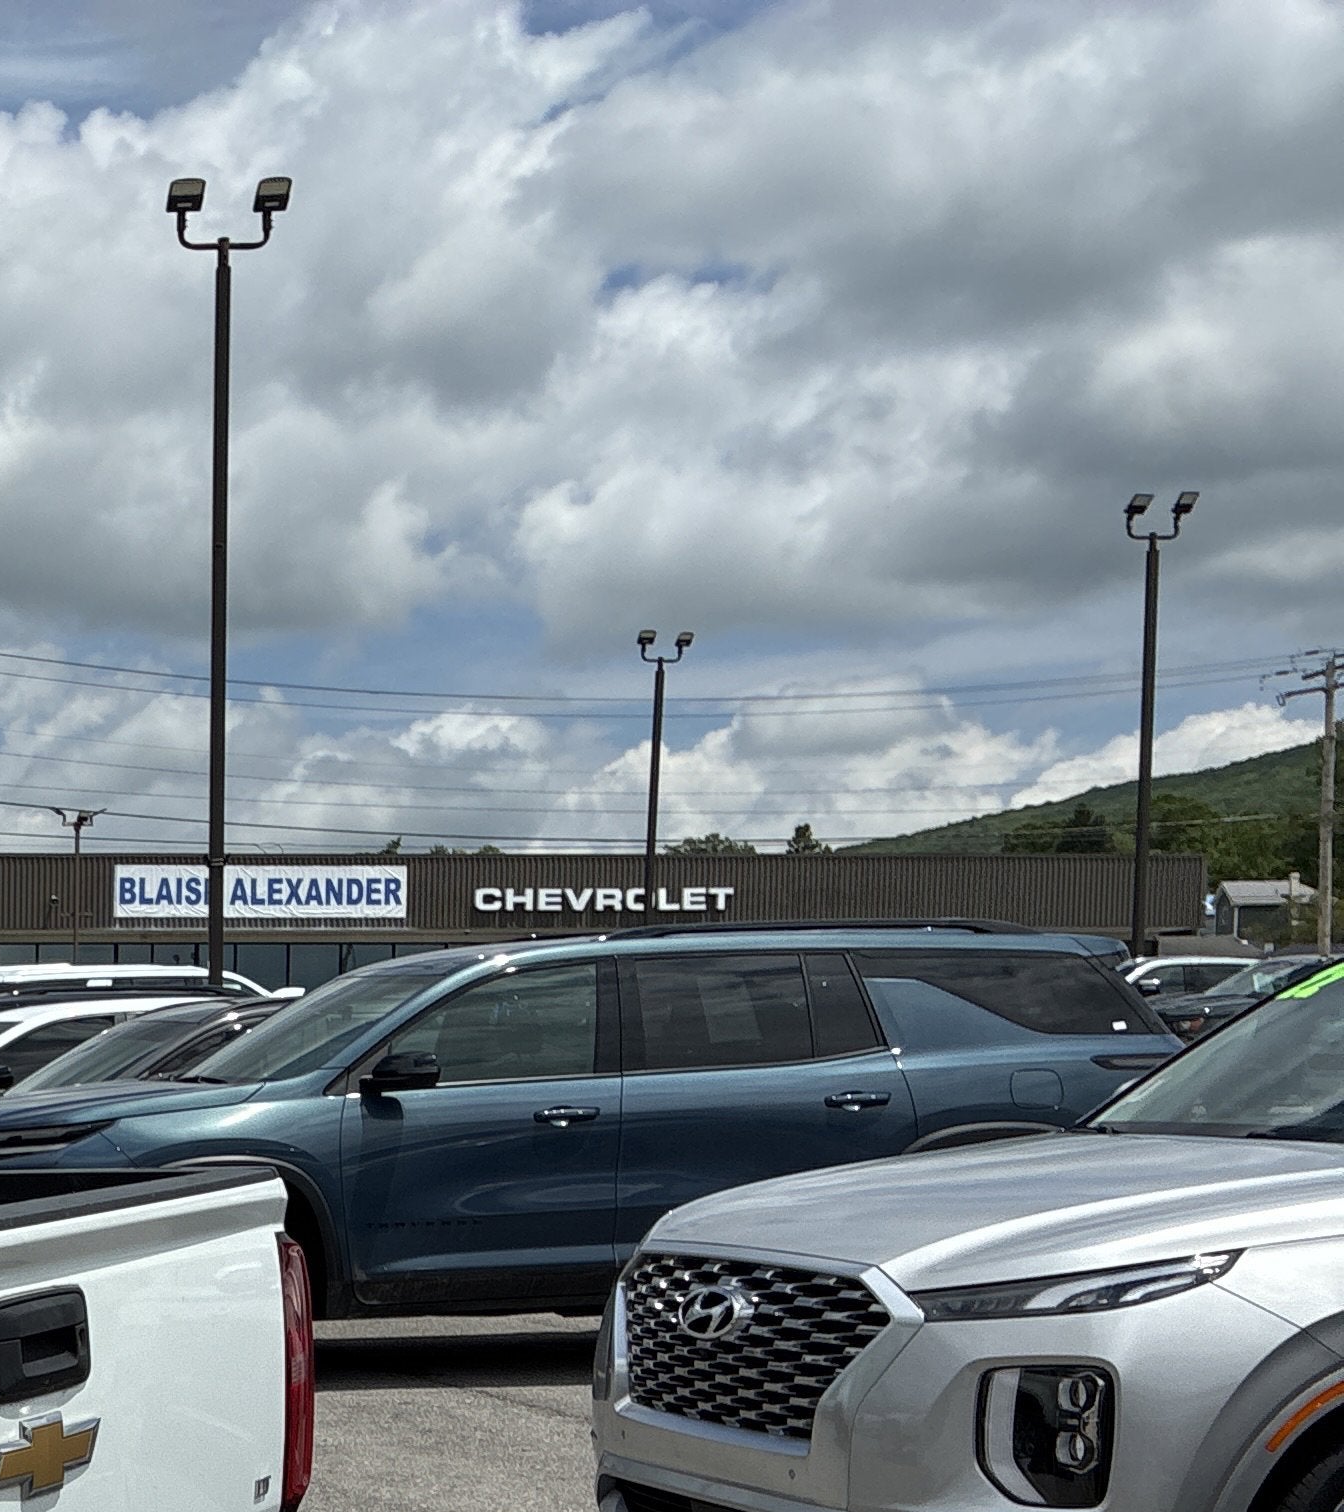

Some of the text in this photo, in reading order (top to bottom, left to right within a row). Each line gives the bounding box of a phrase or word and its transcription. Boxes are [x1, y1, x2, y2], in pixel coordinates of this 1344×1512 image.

[119, 877, 402, 905] BLAIS ALEXANDER
[474, 887, 735, 911] CHEVROLET
